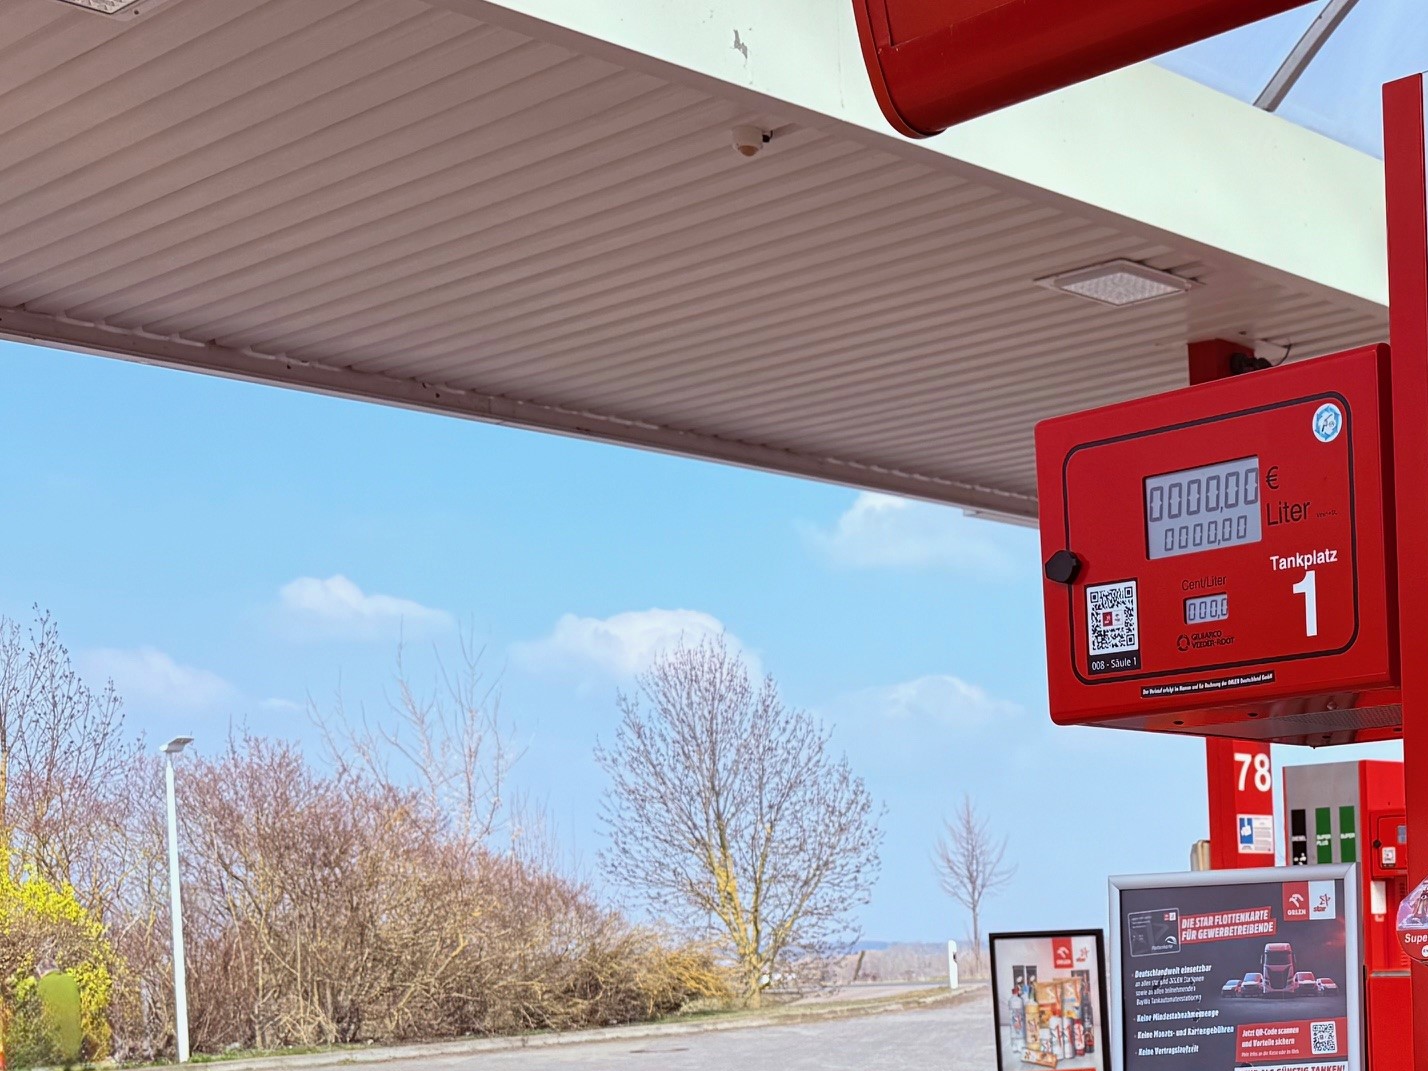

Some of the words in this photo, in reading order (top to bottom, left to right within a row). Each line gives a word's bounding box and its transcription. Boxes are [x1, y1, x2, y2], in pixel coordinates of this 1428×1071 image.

[1266, 500, 1310, 526] Liter
[1269, 548, 1338, 571] Tankplatz
[1181, 575, 1227, 591] Cent/Liter
[1292, 569, 1318, 637] 1
[1091, 660, 1105, 671] 008
[1110, 658, 1132, 669] Säule
[1233, 752, 1272, 792] 78
[1181, 917, 1195, 929] DIE
[1195, 915, 1213, 928] STAR
[1214, 909, 1269, 926] FLOTTENKARTE
[1181, 928, 1197, 941] FÜR
[1198, 922, 1274, 940] GEWERBETREIBENDE
[1135, 966, 1180, 978] Deutschlandweit
[1181, 964, 1212, 973] einsetzbar
[1136, 1014, 1152, 1023] Keine
[1137, 1031, 1153, 1039] Keine
[1255, 1028, 1277, 1037] QR-Code
[1138, 1047, 1154, 1056] Keine
